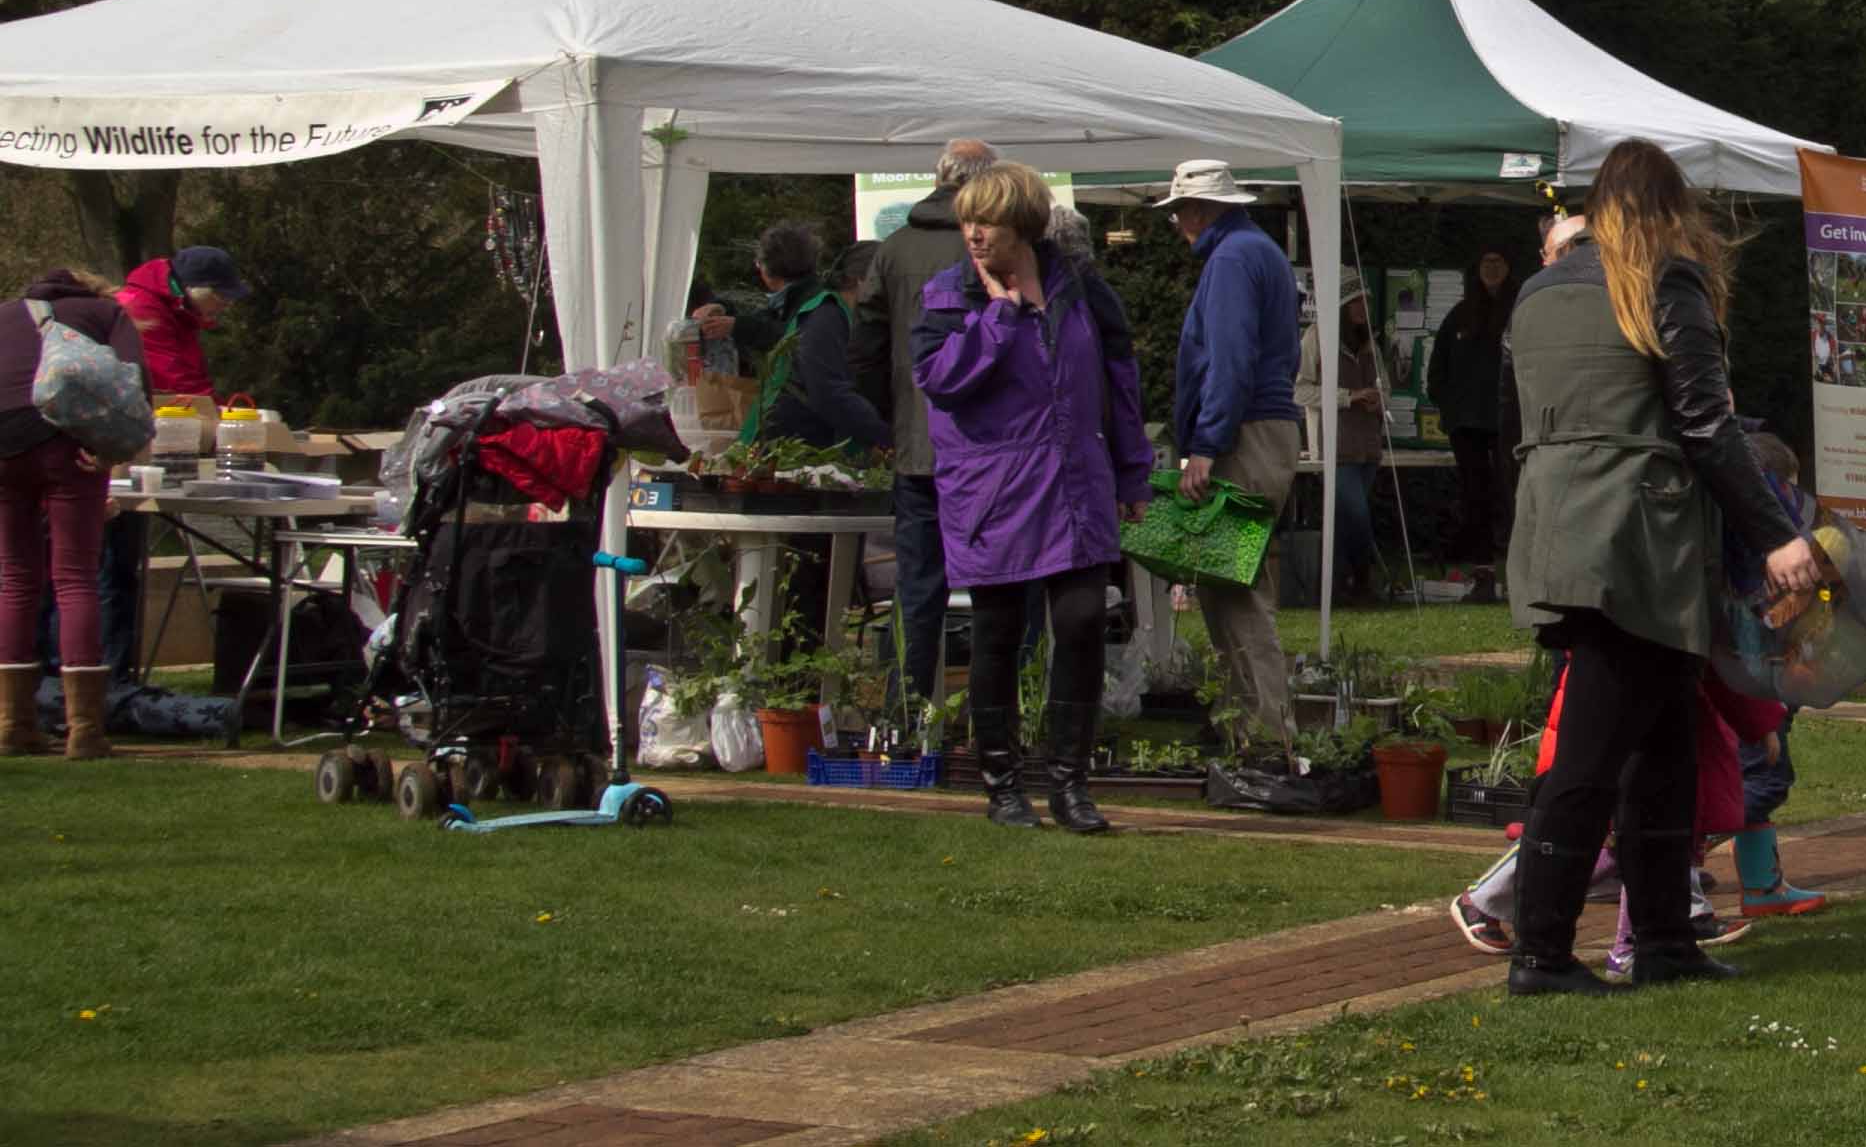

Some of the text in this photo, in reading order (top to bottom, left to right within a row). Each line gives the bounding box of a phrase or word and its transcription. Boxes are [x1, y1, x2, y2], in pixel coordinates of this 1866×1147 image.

[82, 125, 194, 155] Wildlife
[201, 125, 241, 155] for
[249, 125, 296, 153] the
[1819, 223, 1850, 241] Get
